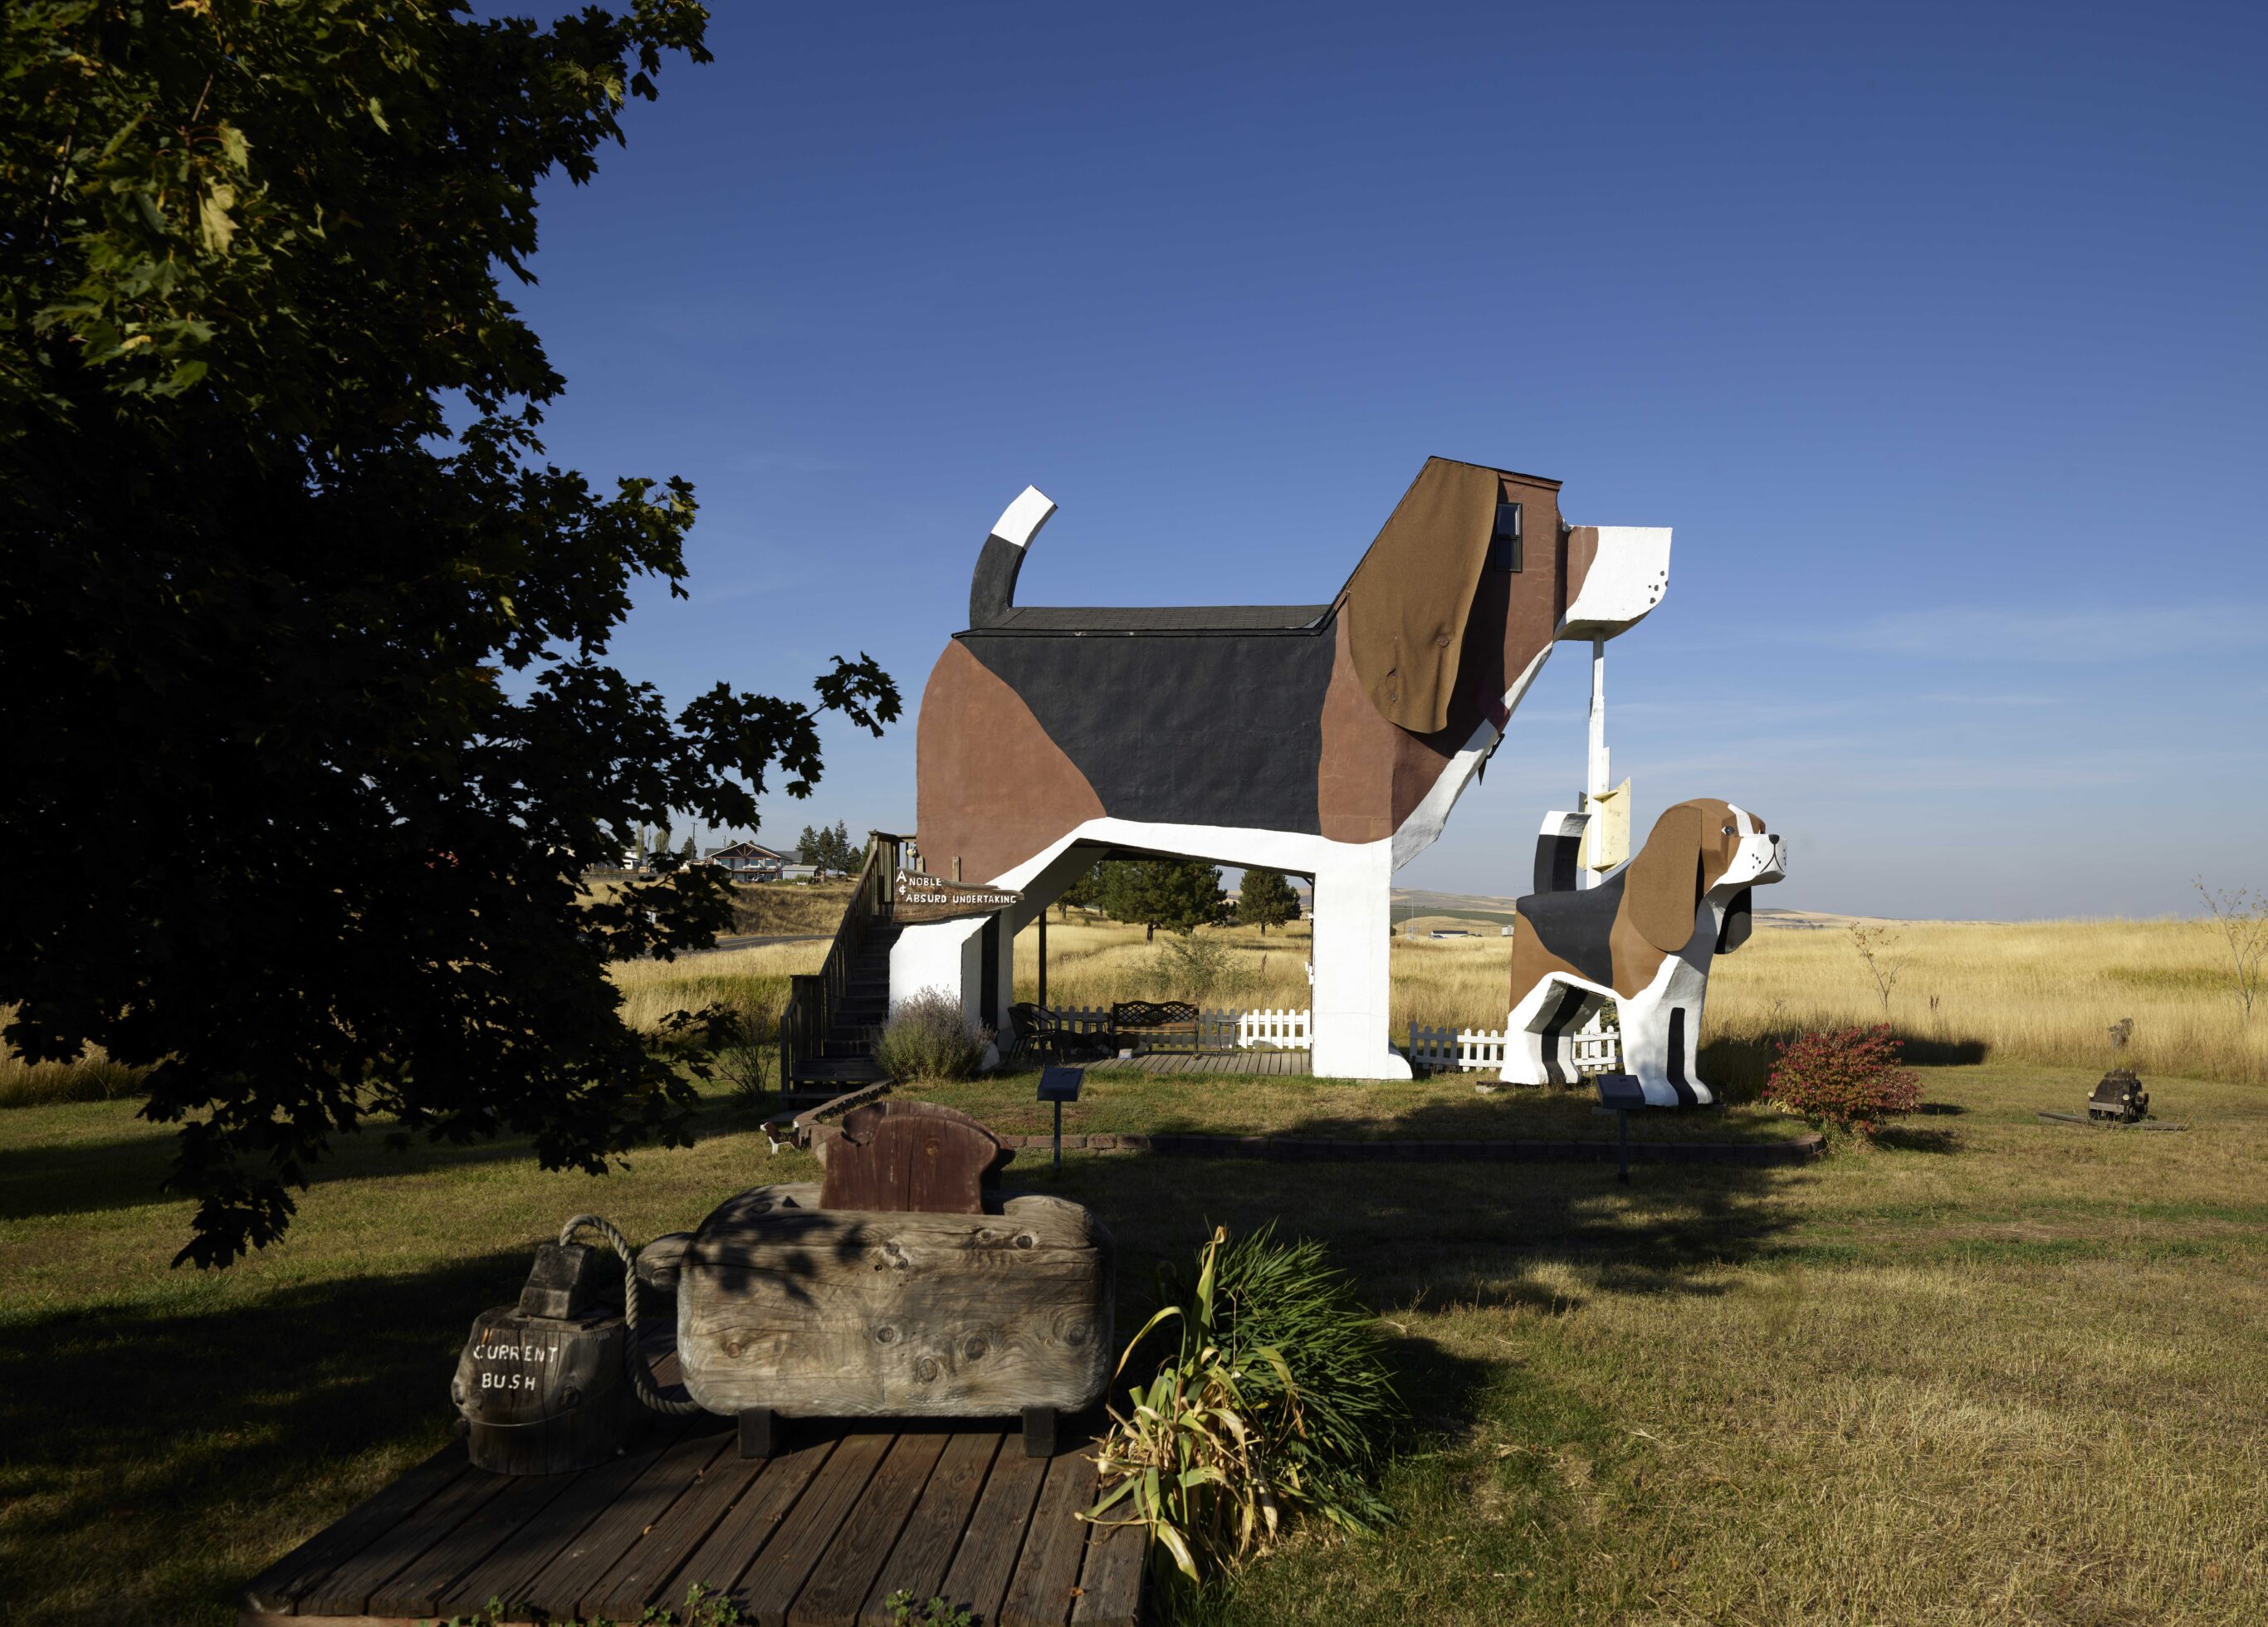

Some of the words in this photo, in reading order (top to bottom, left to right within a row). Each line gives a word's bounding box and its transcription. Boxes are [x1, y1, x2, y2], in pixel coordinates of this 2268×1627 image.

[896, 870, 907, 882] A
[909, 877, 942, 887] NOBLE
[906, 894, 947, 903] ABSURD
[473, 1344, 559, 1363] CURRENT
[481, 1371, 536, 1390] BUSH
